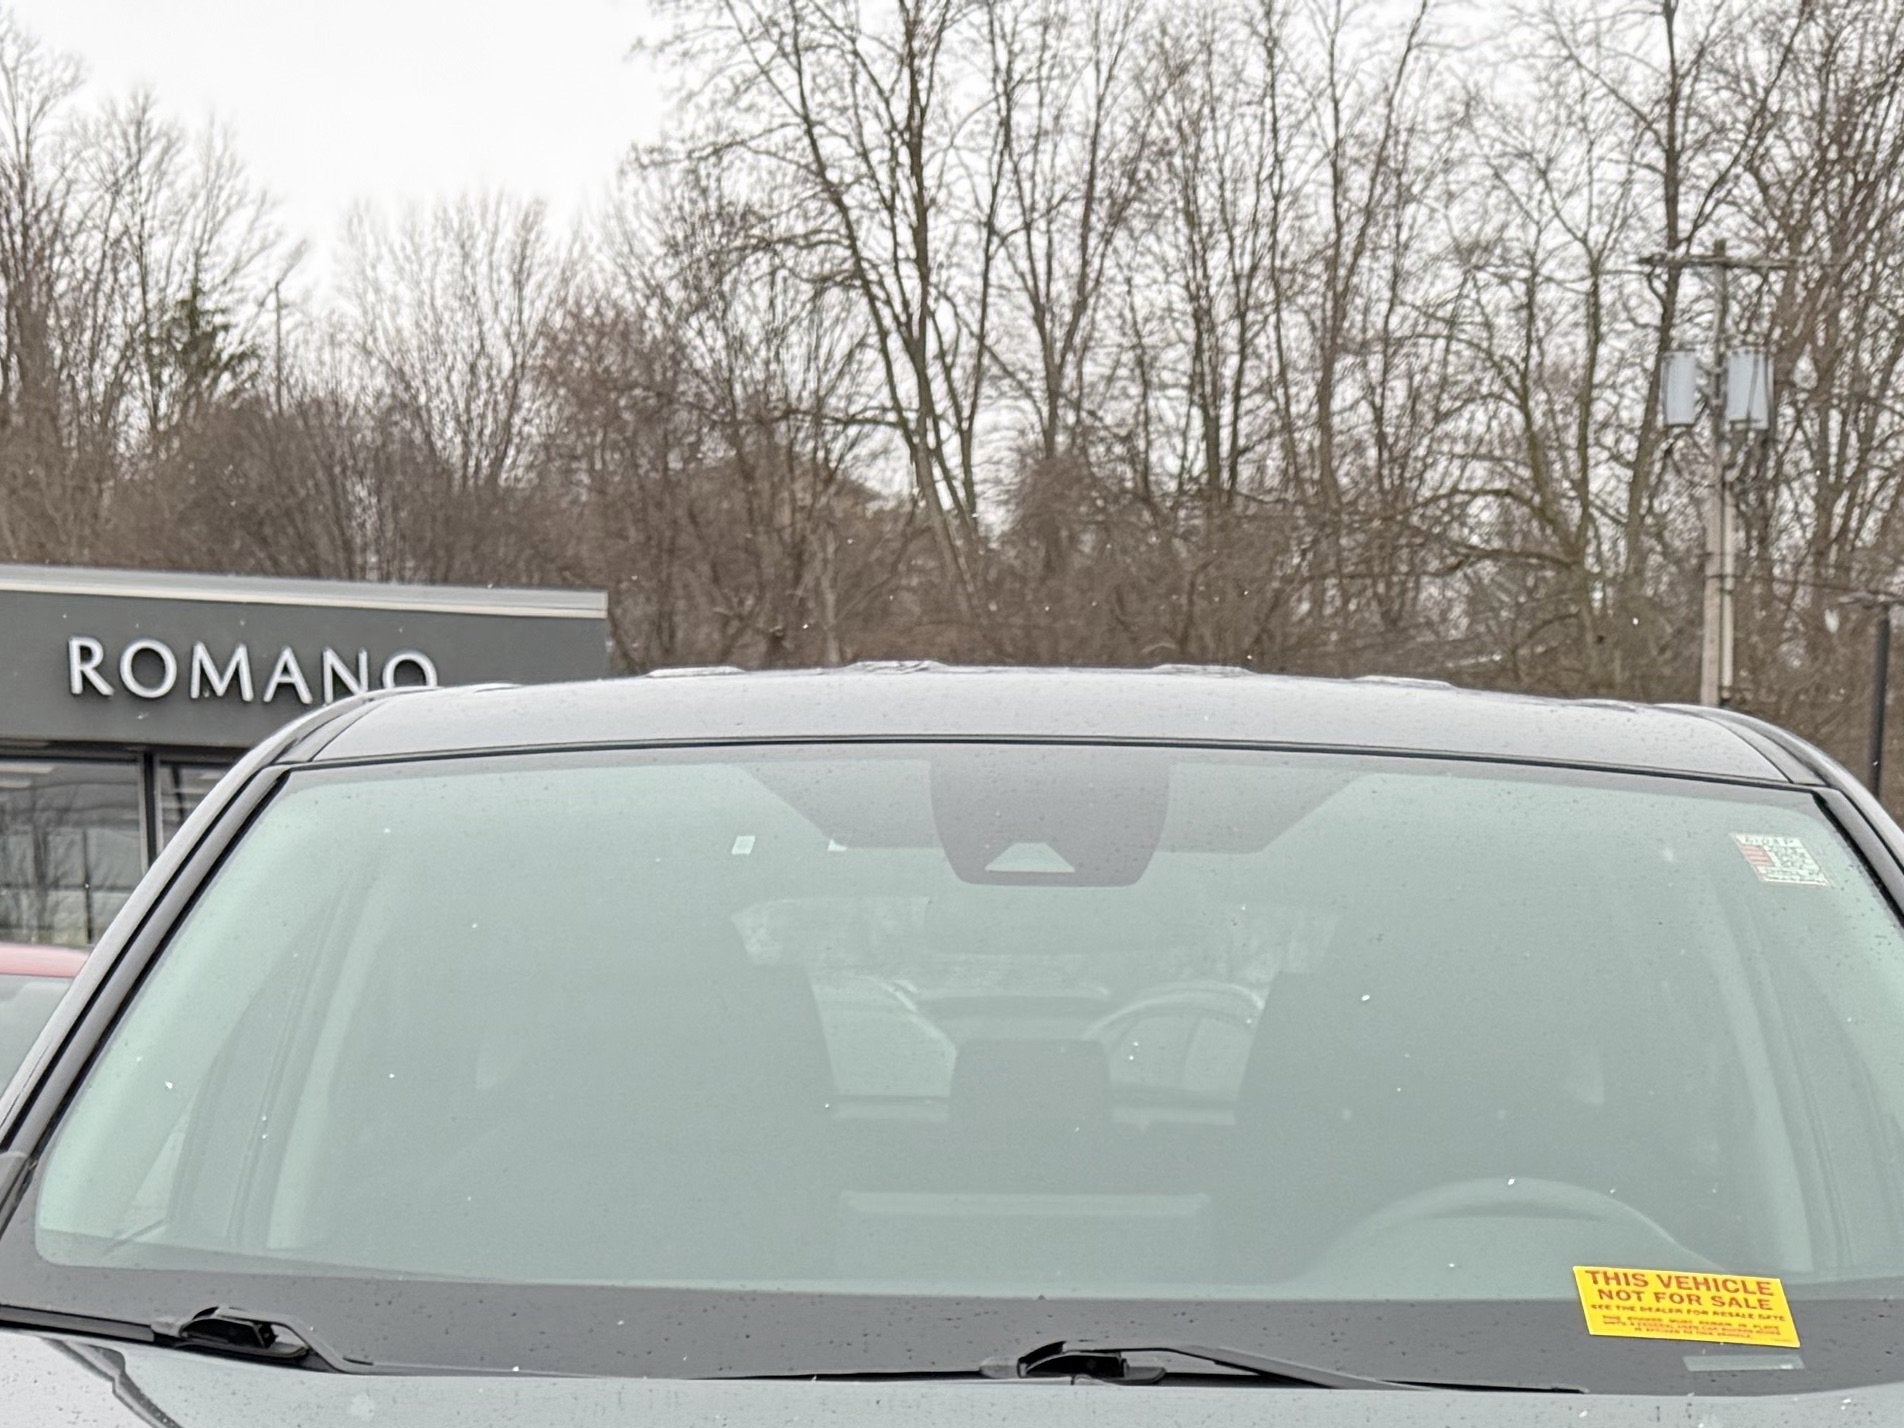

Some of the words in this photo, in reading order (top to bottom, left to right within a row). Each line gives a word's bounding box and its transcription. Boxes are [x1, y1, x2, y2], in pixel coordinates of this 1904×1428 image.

[68, 636, 438, 705] ROMANO
[1585, 1270, 1649, 1288] THIS
[1656, 1273, 1775, 1297] VEHICLE
[1597, 1288, 1645, 1303] NOT
[1653, 1291, 1704, 1307] FOR
[1710, 1295, 1774, 1311] SALE
[1616, 1304, 1636, 1312] THE
[1639, 1306, 1683, 1314] DEALER
[1686, 1308, 1709, 1316] FOR
[1712, 1310, 1755, 1320] RESALE
